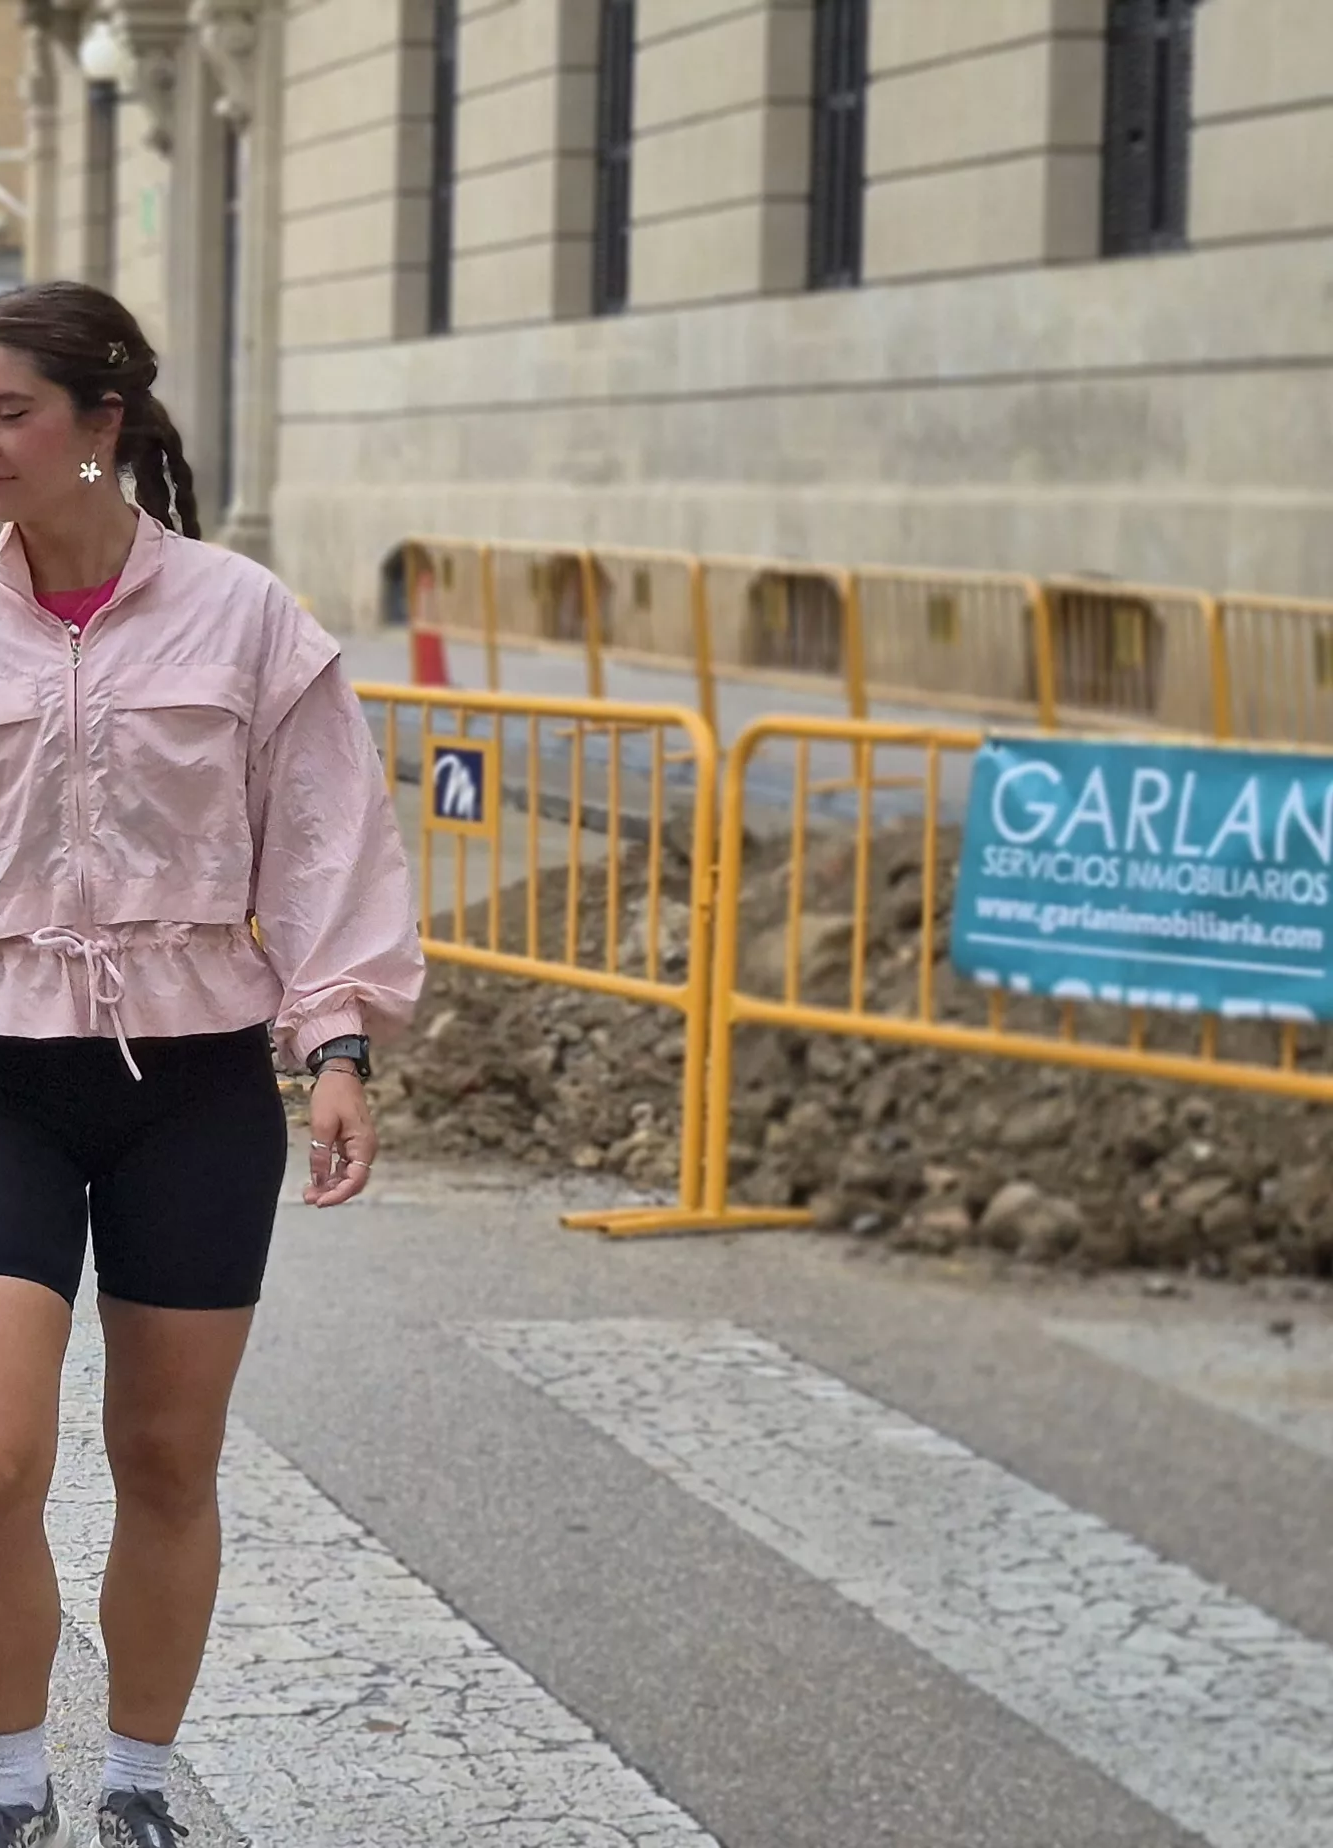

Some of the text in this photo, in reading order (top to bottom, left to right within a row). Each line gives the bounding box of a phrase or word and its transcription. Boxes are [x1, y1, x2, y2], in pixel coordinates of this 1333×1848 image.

[991, 760, 1333, 866] GARLAN
[981, 845, 1329, 906] SERVICIOS INMOBILIARIOS
[975, 896, 1324, 951] www.garlaninmobiliaria.com
